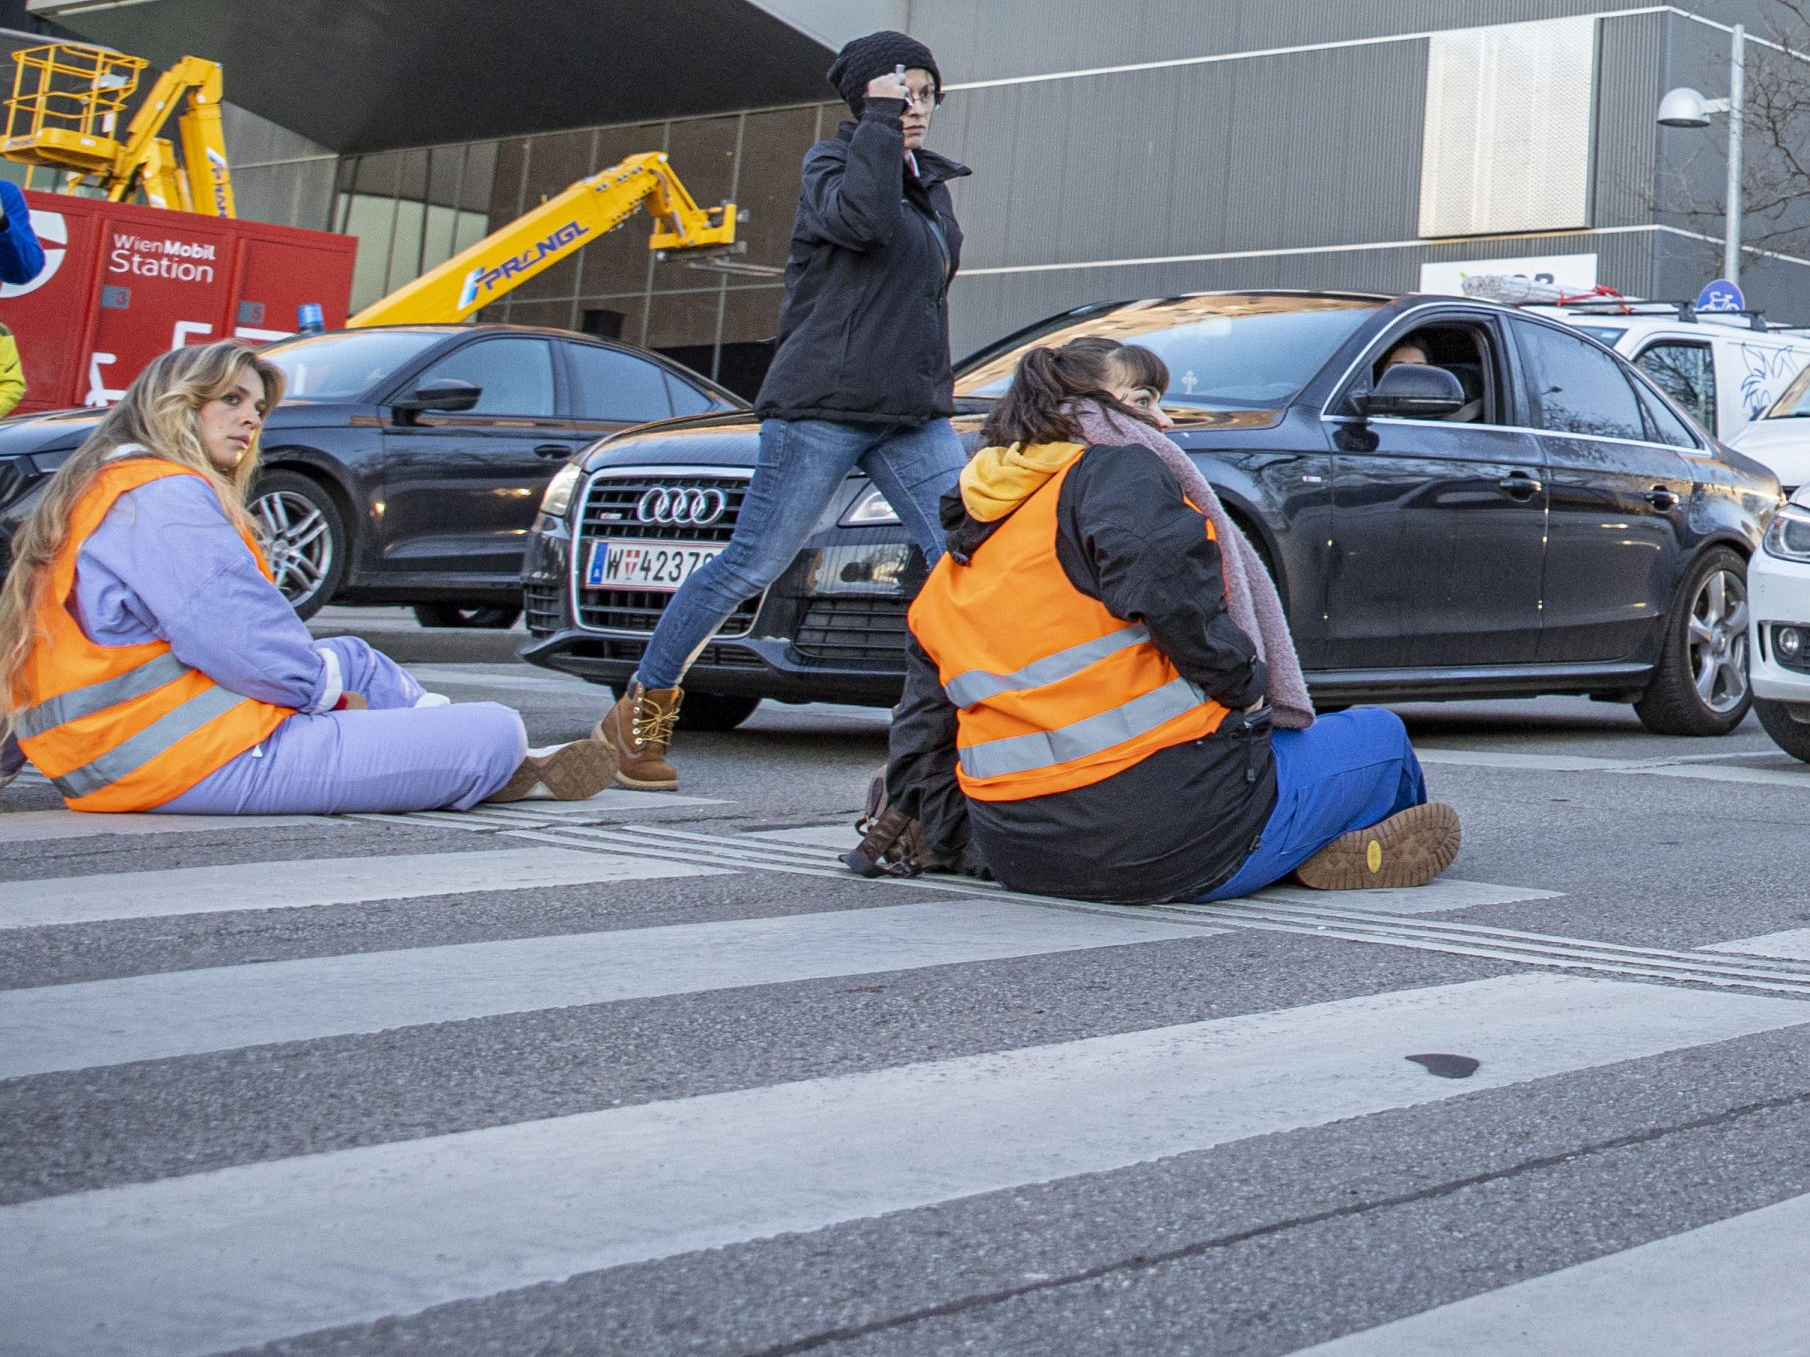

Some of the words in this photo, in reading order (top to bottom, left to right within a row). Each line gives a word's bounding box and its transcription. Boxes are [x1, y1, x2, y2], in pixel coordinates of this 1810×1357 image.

[113, 233, 216, 261] WienMobil
[109, 249, 214, 283] Station
[606, 548, 624, 580] W
